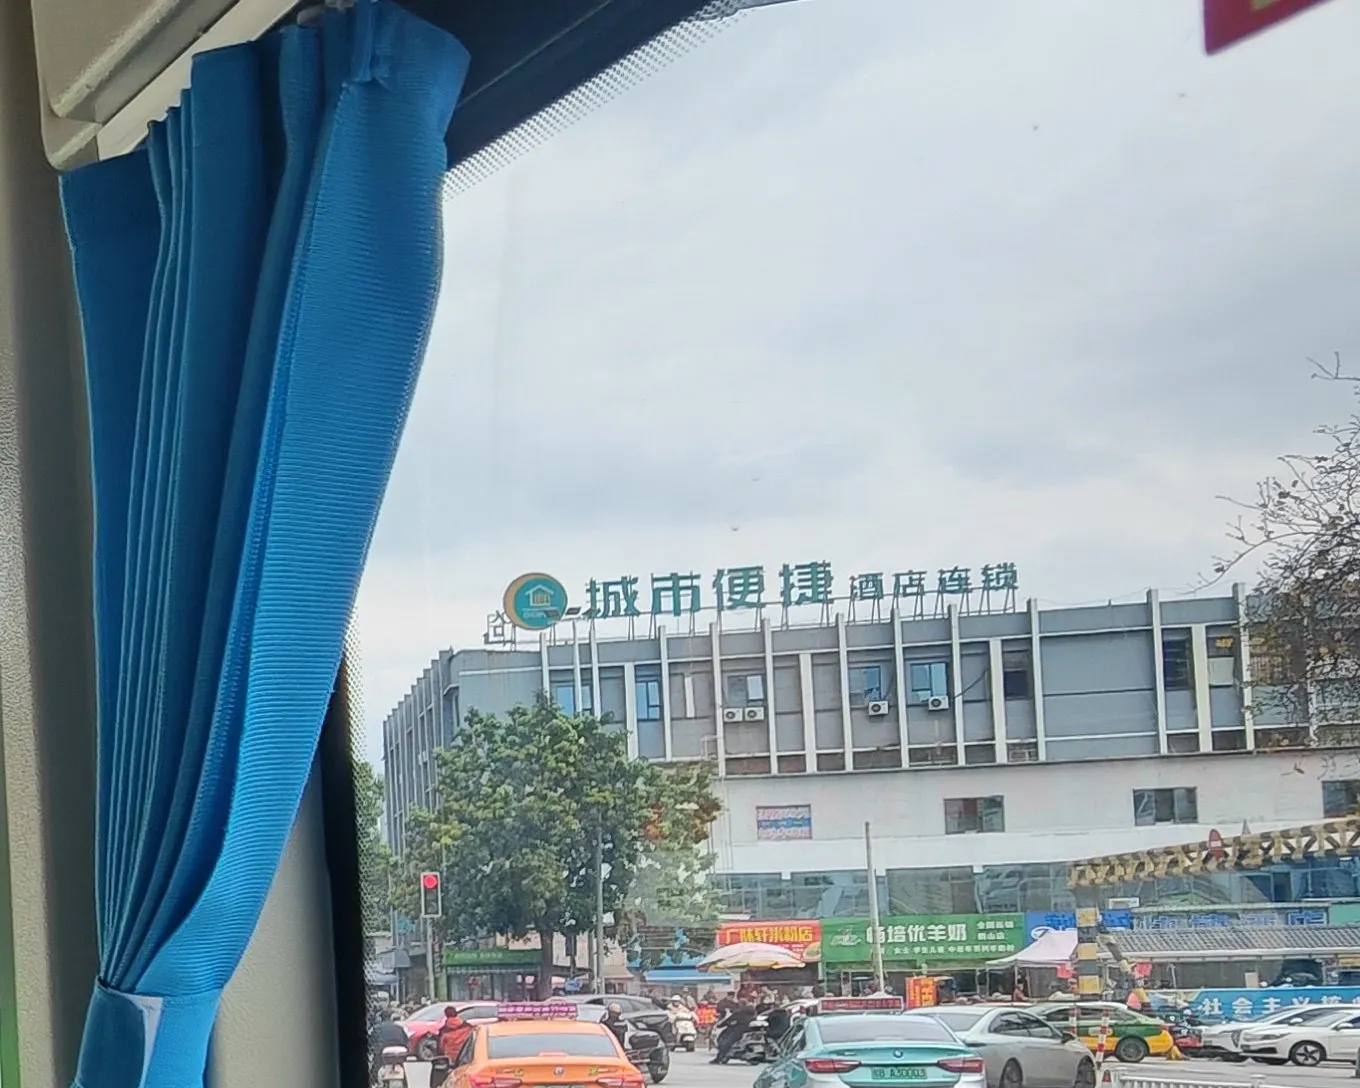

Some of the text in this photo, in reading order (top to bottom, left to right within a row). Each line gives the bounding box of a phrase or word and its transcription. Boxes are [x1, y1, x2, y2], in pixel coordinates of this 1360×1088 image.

[582, 560, 1018, 618] 城市便捷 酒店连锁
